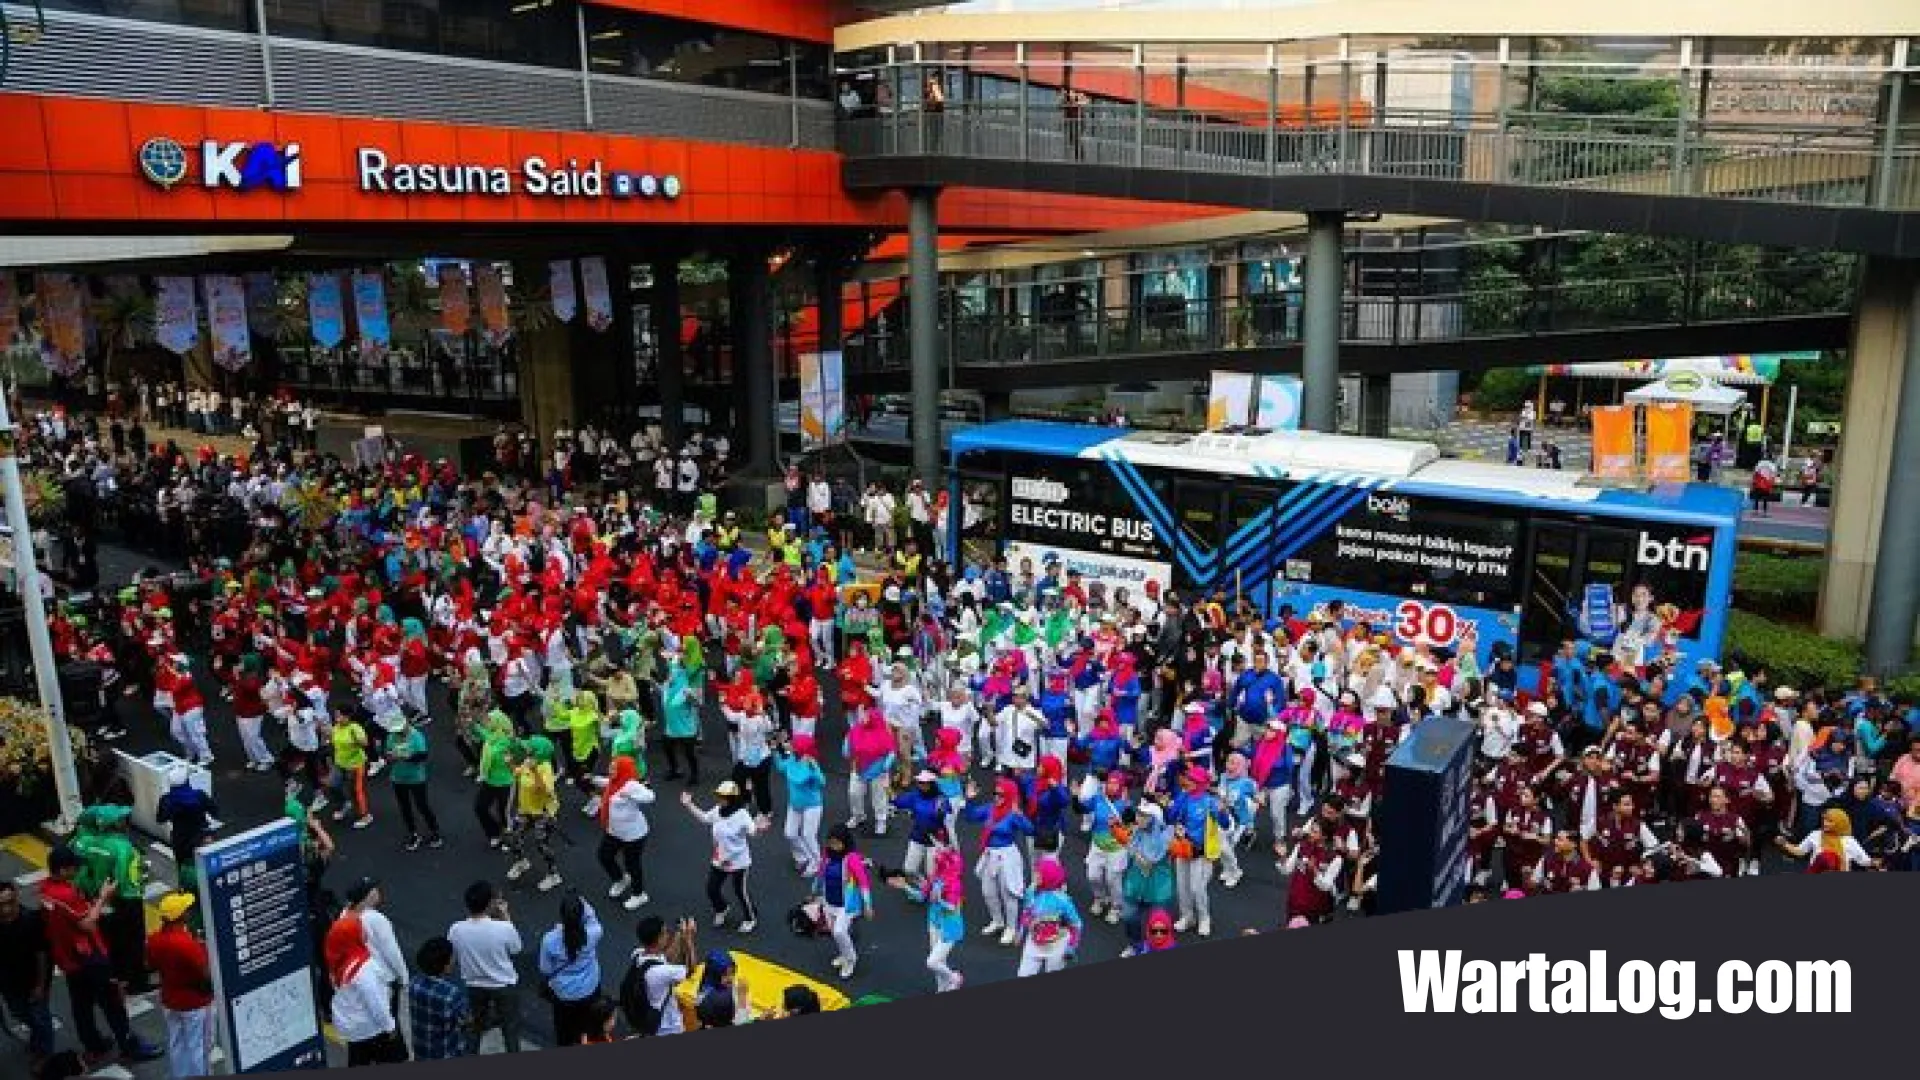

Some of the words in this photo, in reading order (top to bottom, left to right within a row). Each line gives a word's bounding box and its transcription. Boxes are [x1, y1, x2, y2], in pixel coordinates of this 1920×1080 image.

[358, 147, 510, 194] Rasuna
[524, 156, 602, 197] Said
[1011, 503, 1107, 535] ELECTRIC
[1112, 517, 1154, 541] BUS
[1637, 531, 1709, 571] btn
